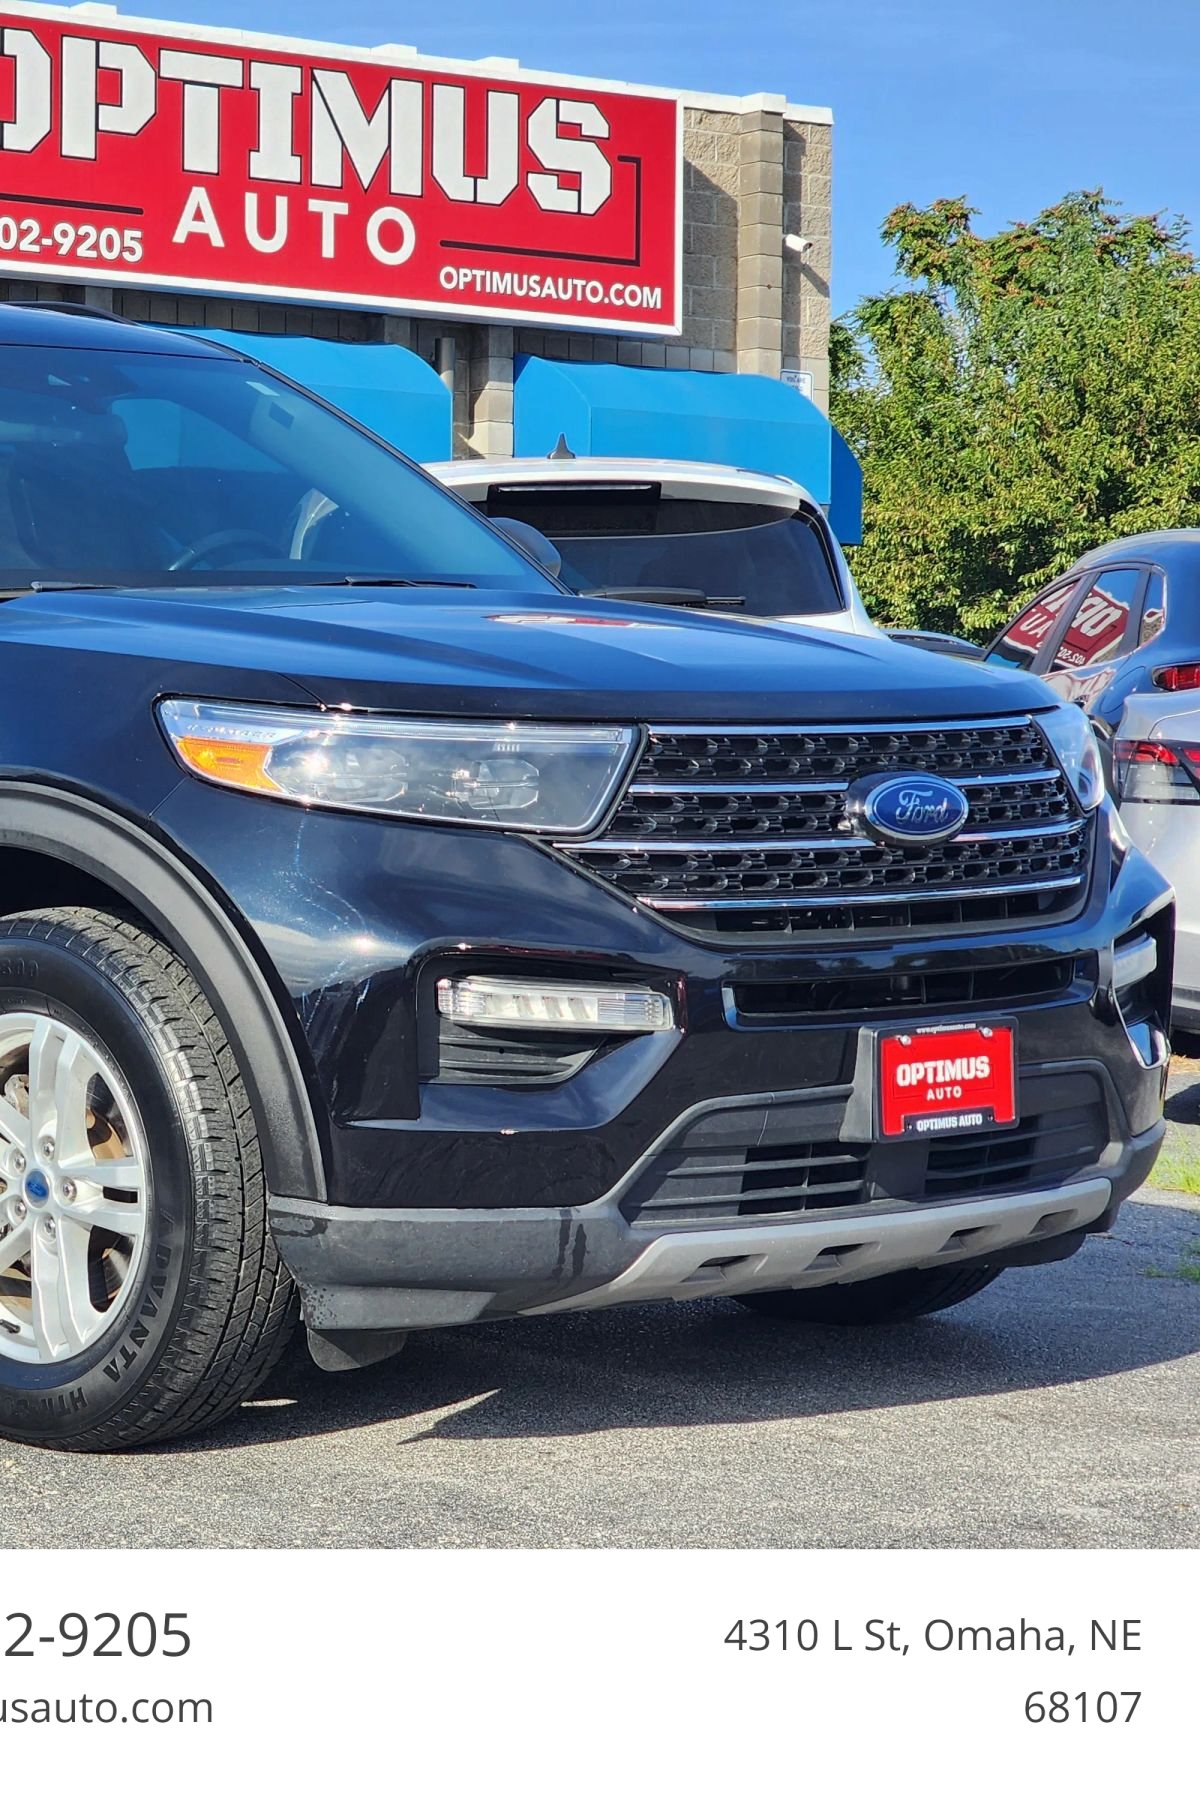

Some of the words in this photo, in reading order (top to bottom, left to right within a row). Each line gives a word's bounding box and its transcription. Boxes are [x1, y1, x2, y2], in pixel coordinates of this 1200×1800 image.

[171, 186, 416, 266] AUTO
[439, 266, 662, 309] OPTIMUSAUTO.COM
[895, 789, 949, 824] Ford
[896, 1055, 990, 1087] OPTIMUS
[926, 1085, 962, 1101] AUTO
[916, 1116, 958, 1133] OPTIMUS
[958, 1113, 983, 1127] AUTO
